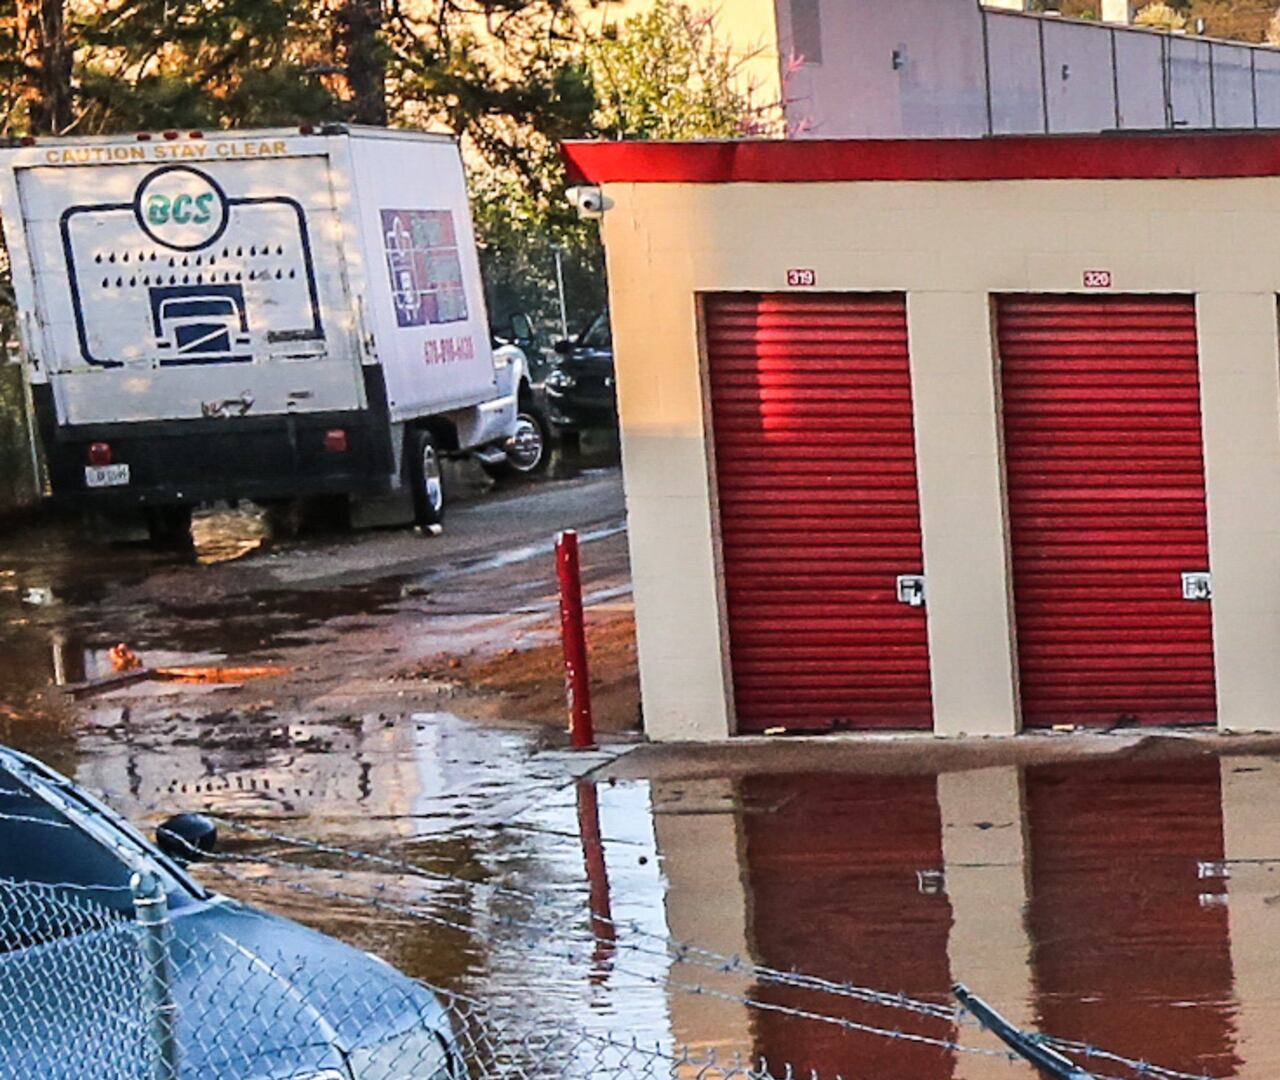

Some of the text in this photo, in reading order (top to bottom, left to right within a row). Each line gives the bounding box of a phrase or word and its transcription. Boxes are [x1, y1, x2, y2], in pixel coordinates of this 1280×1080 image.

[46, 141, 287, 163] CAUTION STAY CLEAR
[148, 192, 213, 225] BCS
[789, 271, 812, 284] 319
[1085, 272, 1109, 286] 320
